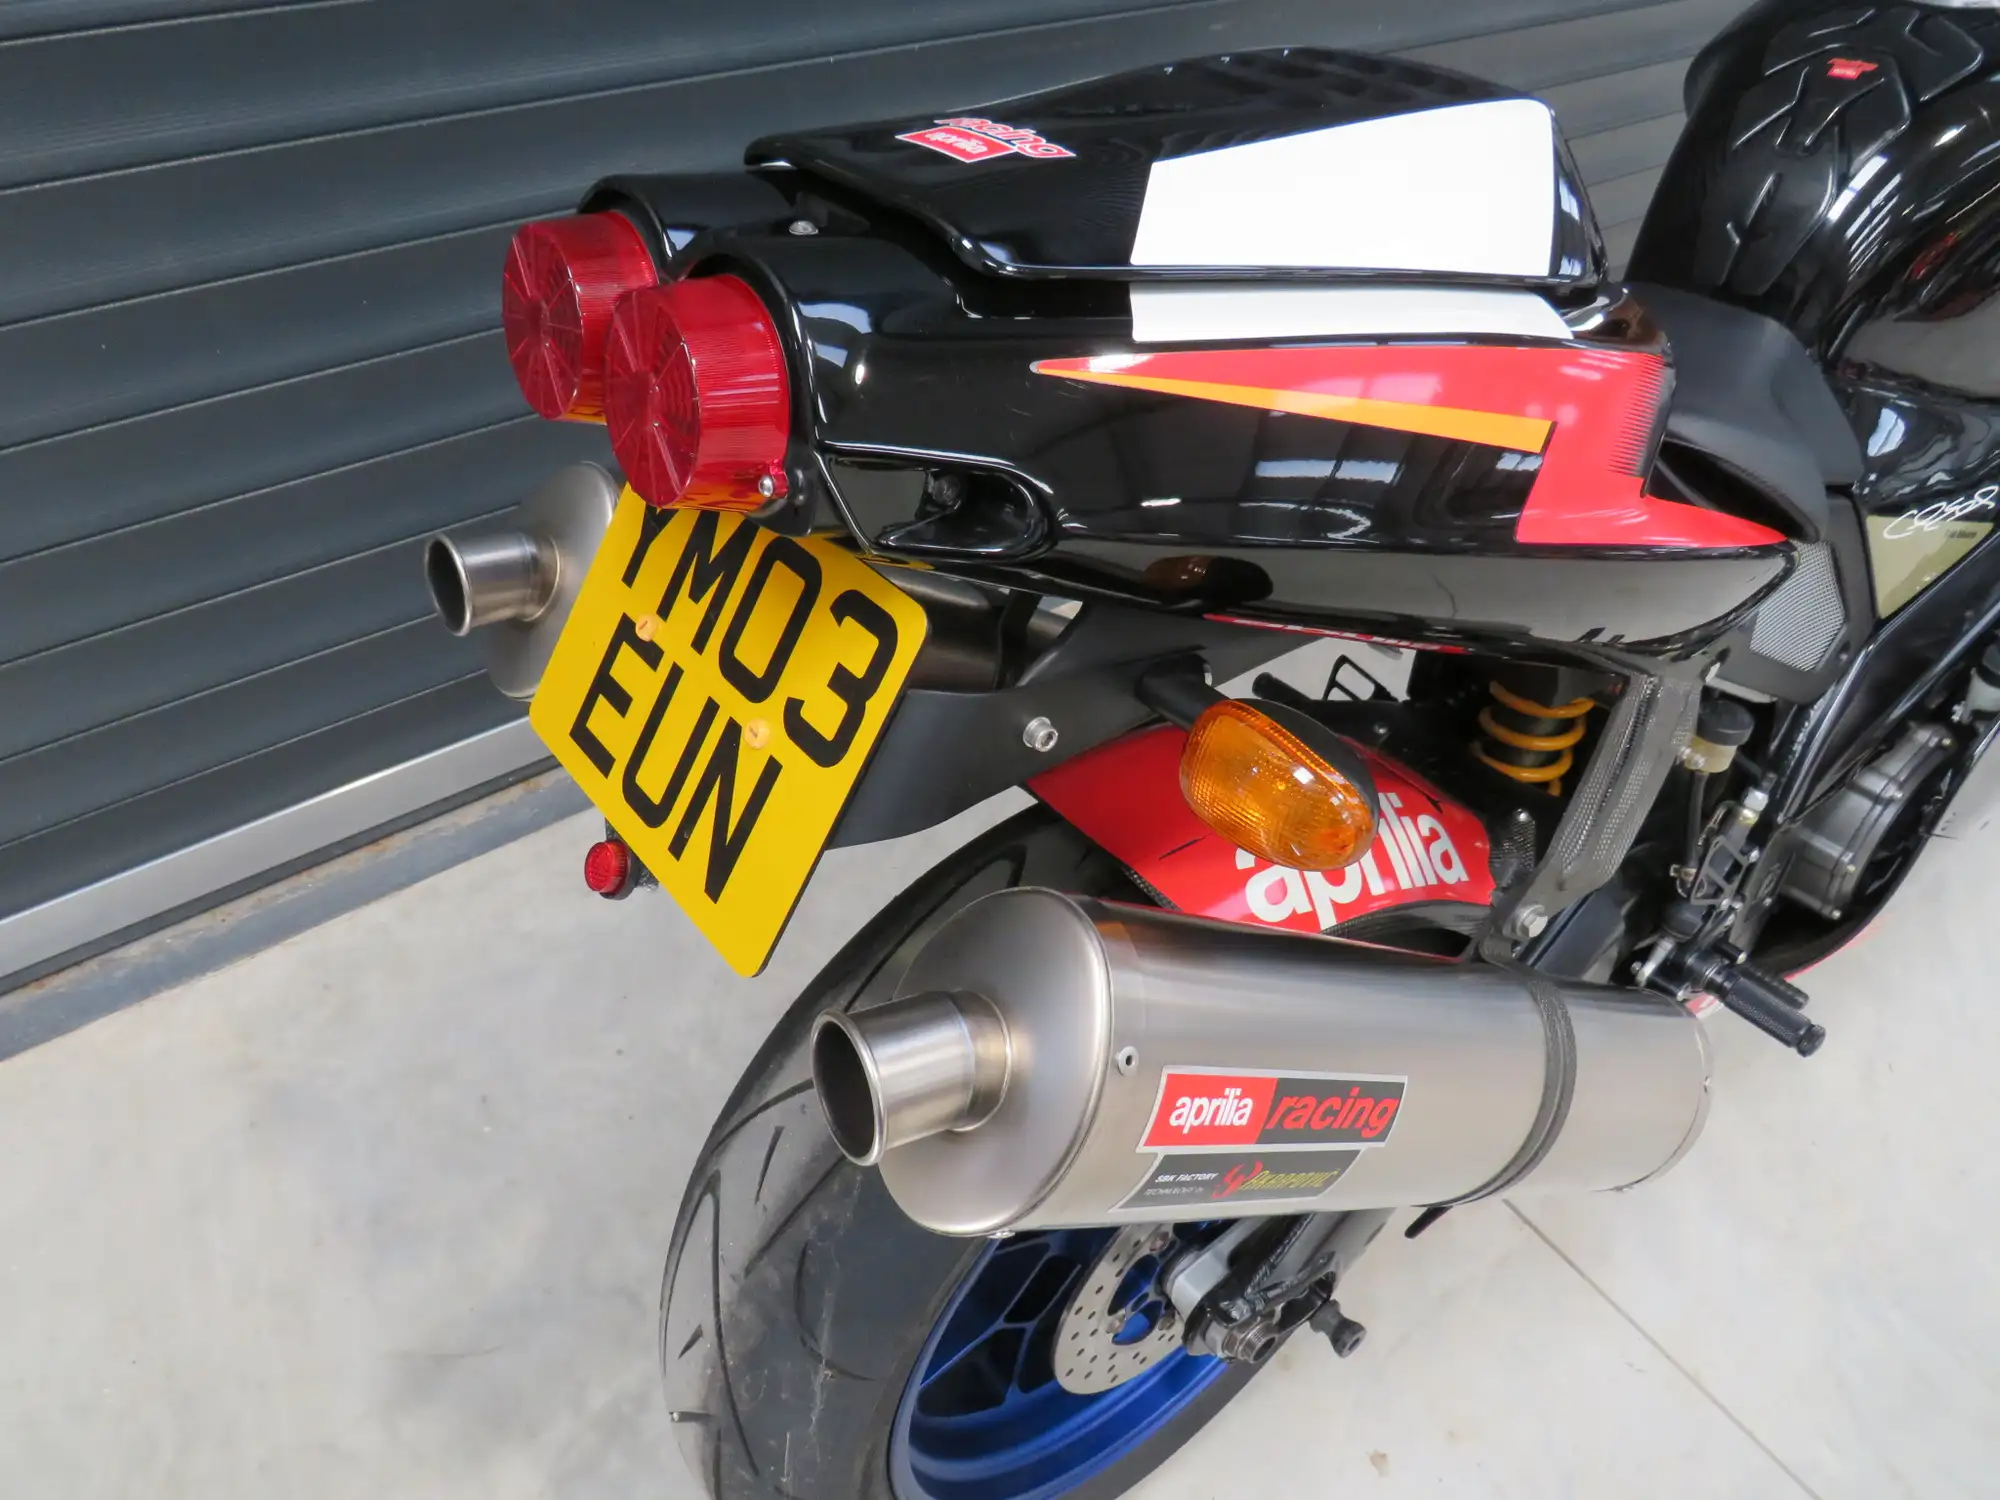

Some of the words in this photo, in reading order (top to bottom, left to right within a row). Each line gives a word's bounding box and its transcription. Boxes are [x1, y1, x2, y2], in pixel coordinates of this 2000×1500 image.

[621, 507, 898, 769] YM03
[568, 611, 784, 905] EUN
[1168, 1087, 1254, 1135] aprilia
[1264, 1086, 1400, 1139] racing
[1176, 1172, 1220, 1183] FACTORY
